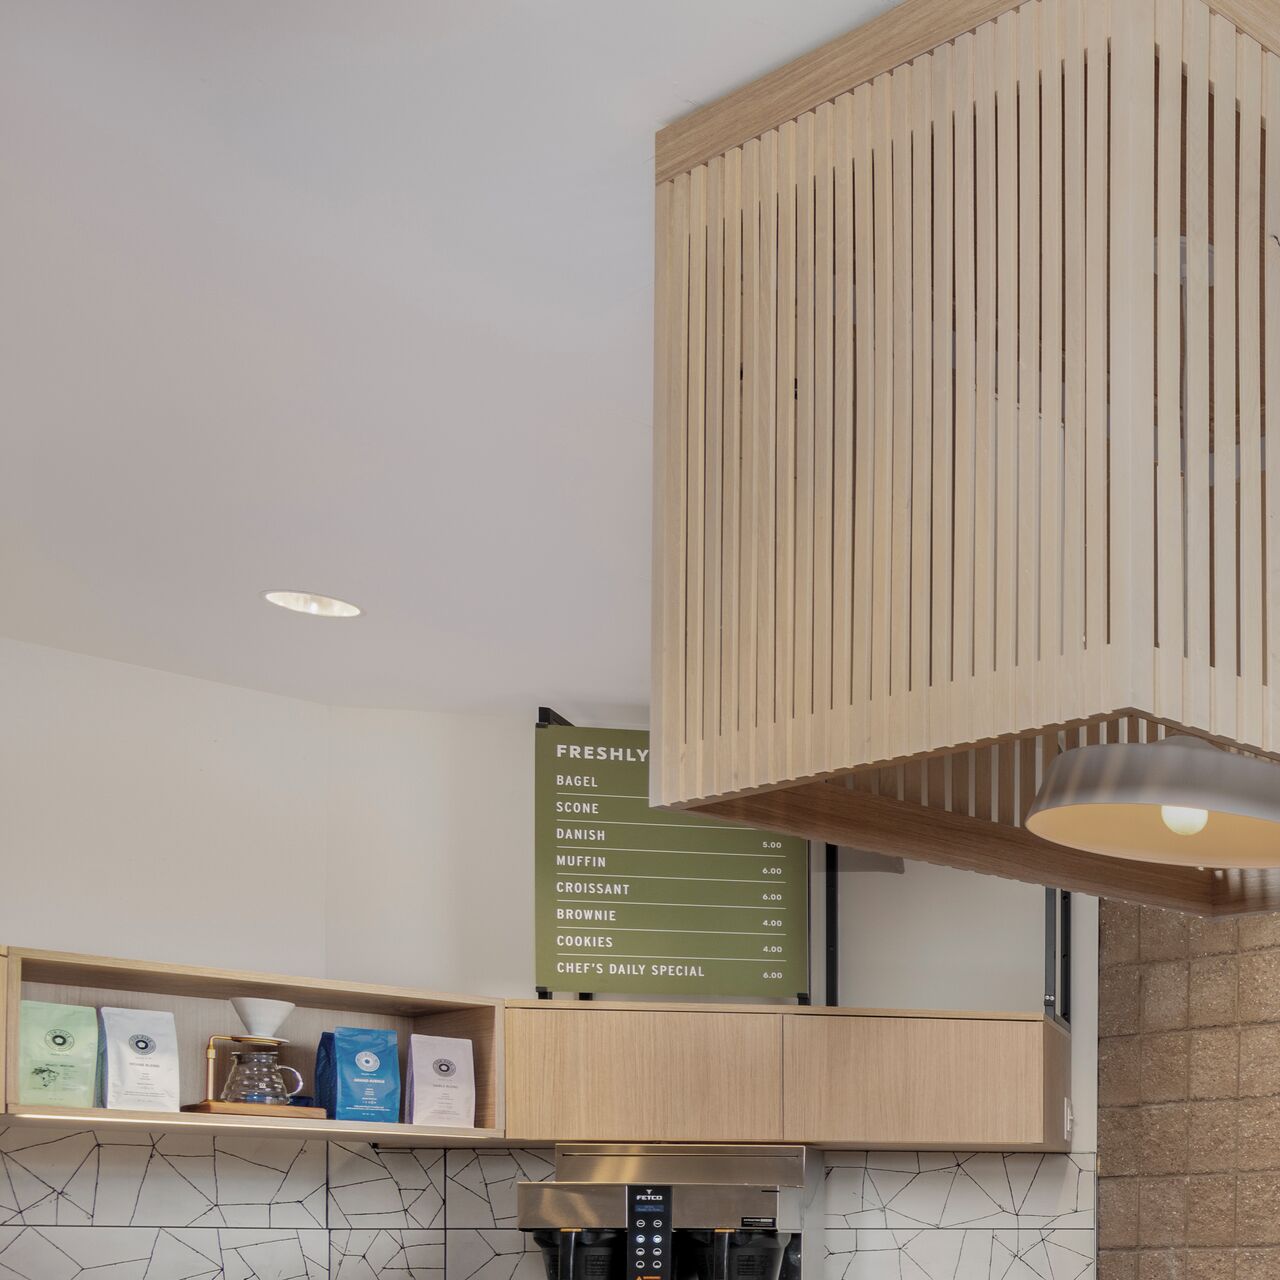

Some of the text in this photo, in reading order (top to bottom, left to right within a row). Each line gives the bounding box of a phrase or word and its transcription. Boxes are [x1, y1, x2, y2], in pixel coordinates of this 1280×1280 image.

[556, 744, 649, 762] FRESHLY
[556, 774, 599, 788] BAGEL
[556, 801, 600, 815] SCONE
[556, 828, 606, 841] DANISH
[762, 841, 782, 849] 5.00
[556, 855, 607, 868] MUFFIN
[762, 867, 782, 875] 6.00
[556, 882, 630, 895] CROISSANT
[762, 893, 782, 901] 6.00
[556, 908, 617, 921] BROWNIE
[762, 919, 783, 927] 4.00
[557, 935, 613, 948] COOKIES
[762, 945, 783, 953] 4.00
[557, 962, 705, 977] CHEF'S DAILY SPECIAL
[763, 971, 783, 979] 6.00
